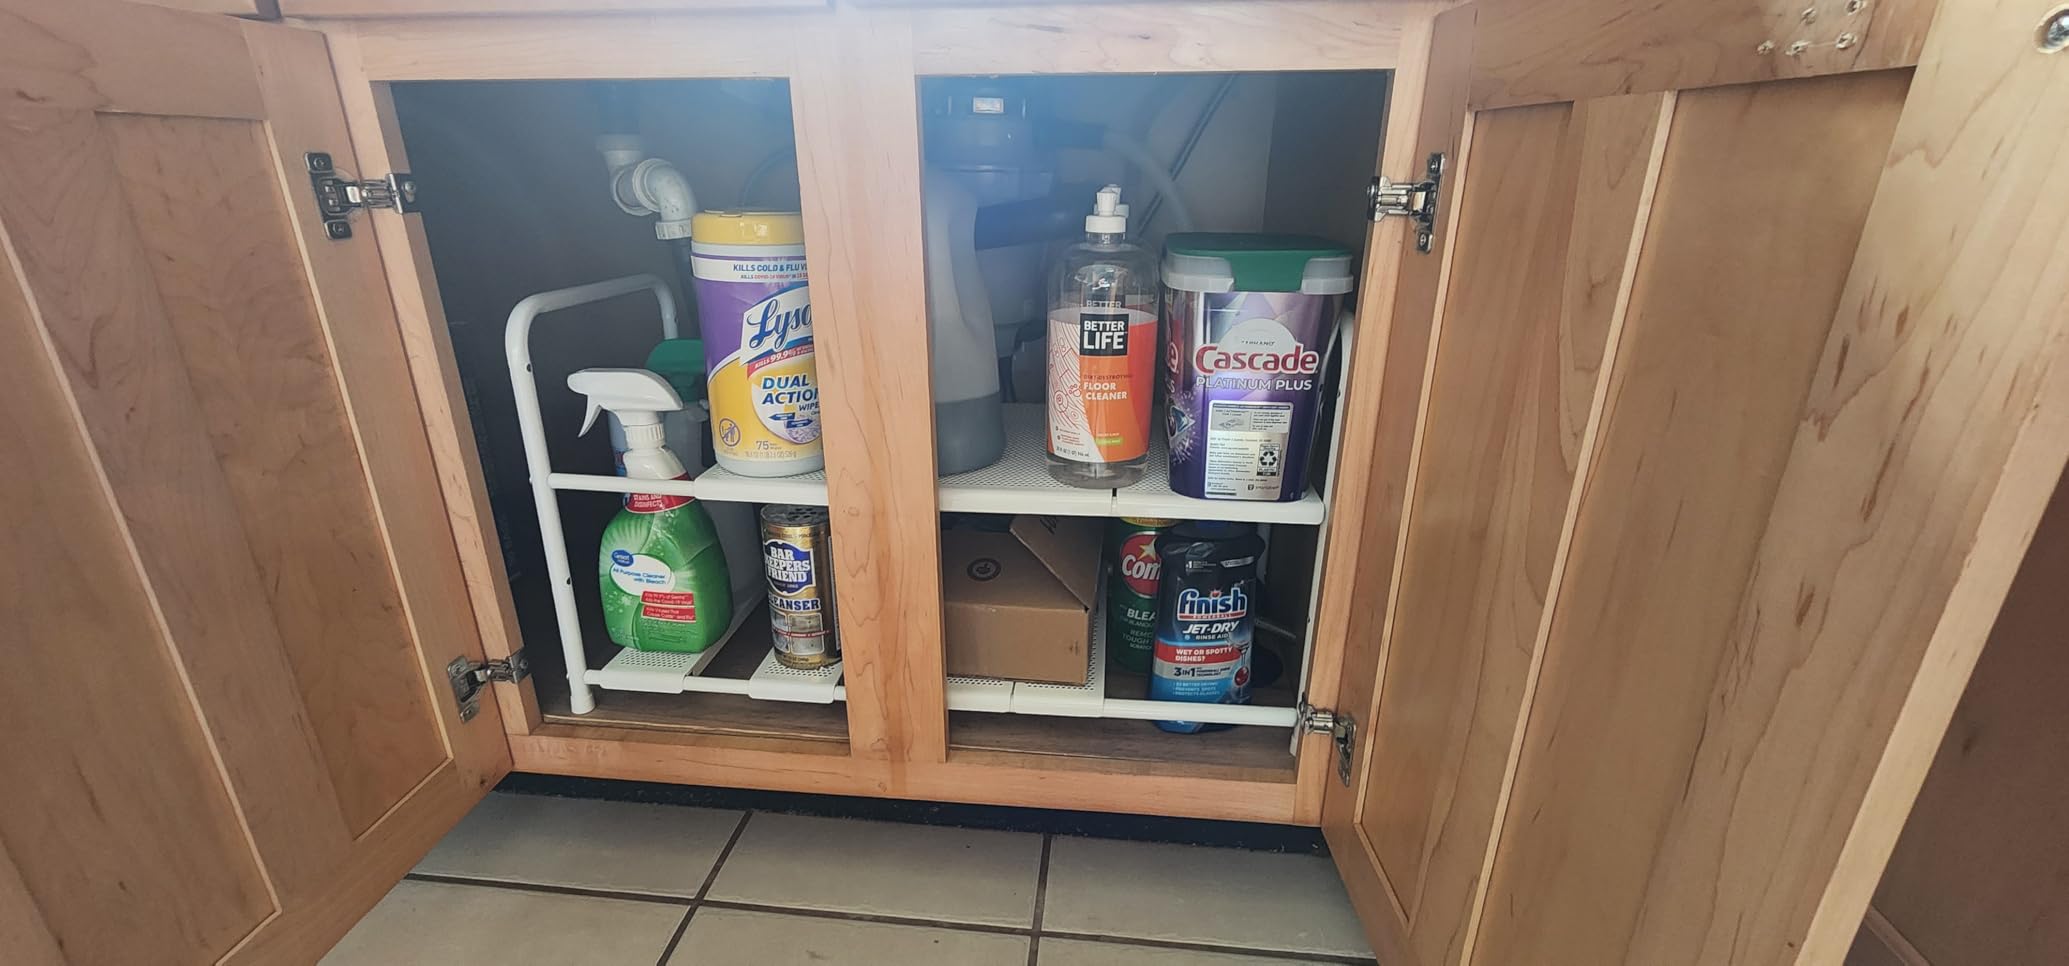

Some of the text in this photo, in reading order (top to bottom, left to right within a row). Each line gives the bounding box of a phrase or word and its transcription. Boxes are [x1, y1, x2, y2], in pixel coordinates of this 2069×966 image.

[733, 264, 755, 272] KILLS
[757, 264, 778, 272] COLD
[779, 264, 785, 272] &
[786, 263, 800, 272] FLU
[1084, 320, 1126, 332] BETTER
[1083, 331, 1125, 350] LIFE
[1195, 344, 1318, 374] Cascade
[762, 374, 810, 390] DUAL
[1083, 381, 1117, 391] FLOOR
[1196, 376, 1313, 391] PLATINUM PLUS
[762, 388, 819, 405] ACTIO
[1085, 391, 1128, 401] CLEANER
[756, 440, 769, 450] 75
[770, 546, 795, 561] BAR
[767, 566, 808, 583] FRIEND
[1178, 588, 1247, 615] finish
[1182, 620, 1240, 635] JET-DRY
[1205, 647, 1233, 655] SPOTTY
